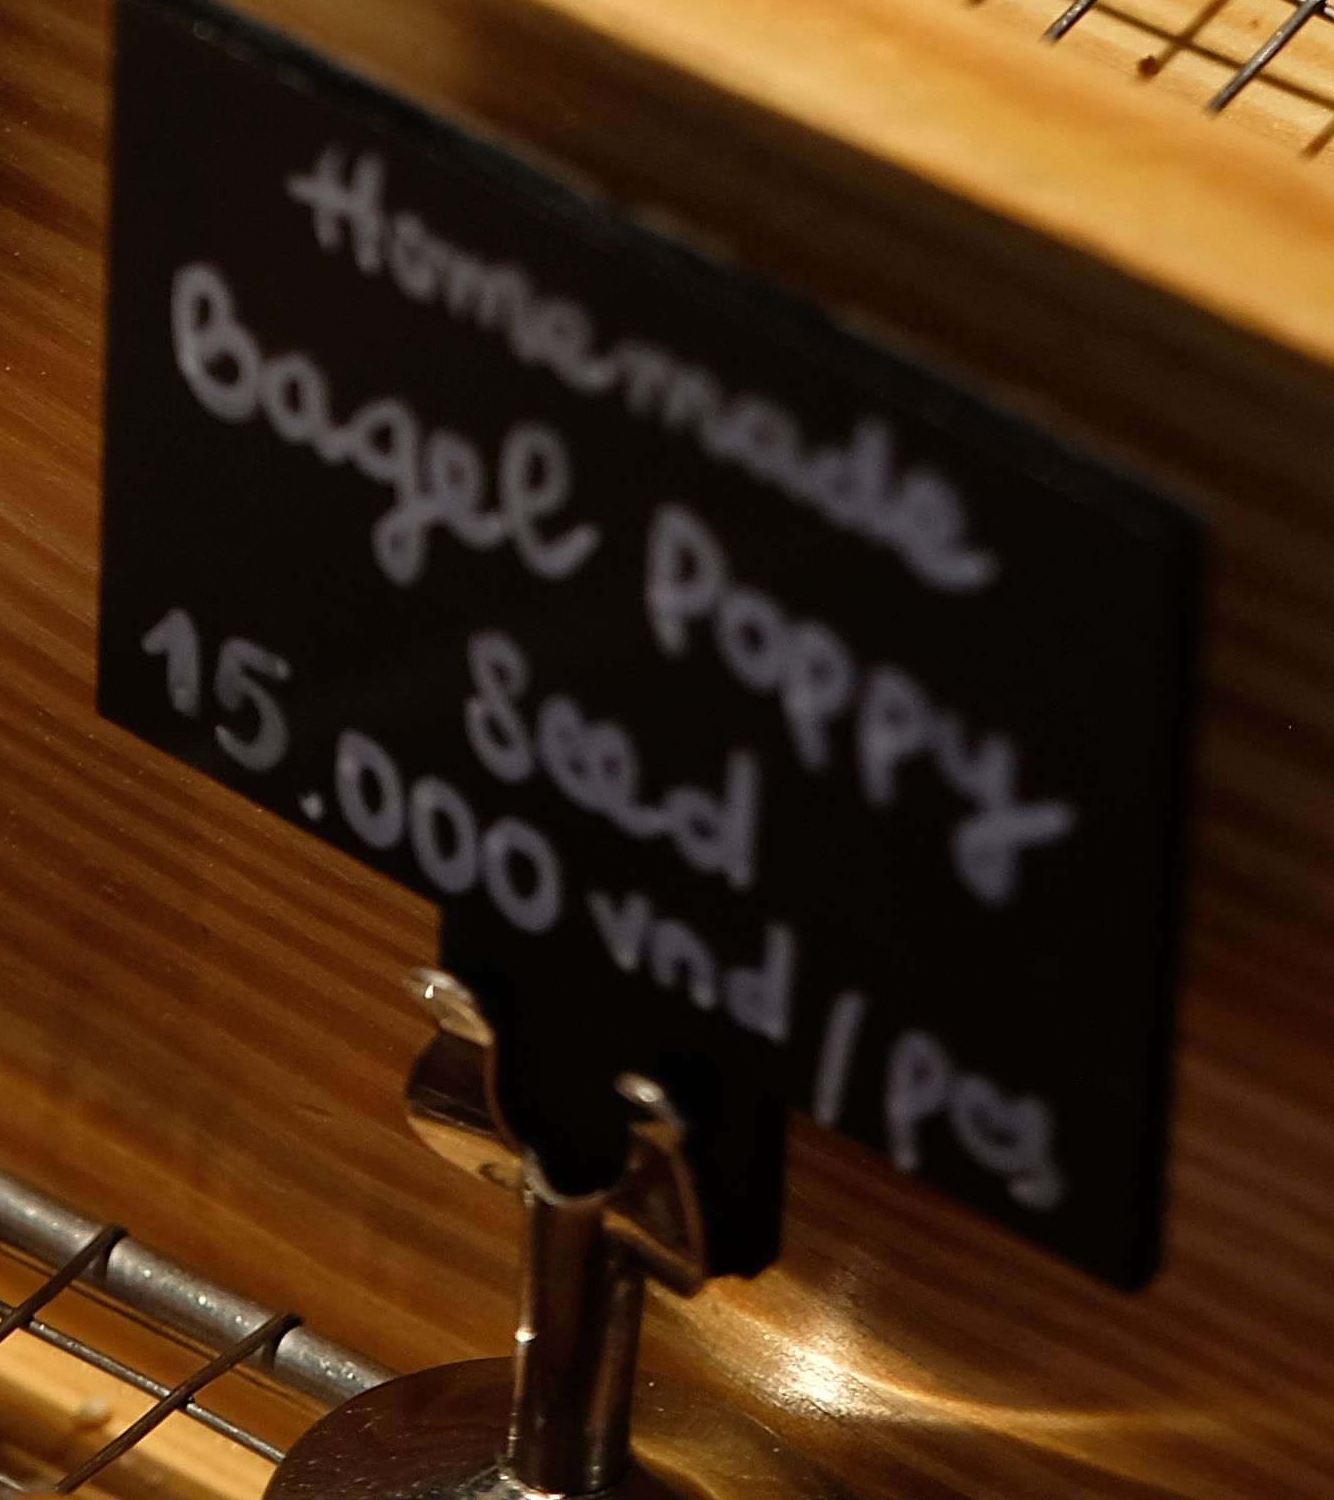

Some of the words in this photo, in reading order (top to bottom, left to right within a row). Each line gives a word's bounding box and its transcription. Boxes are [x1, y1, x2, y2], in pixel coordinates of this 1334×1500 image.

[171, 262, 596, 586] Bagel
[286, 140, 998, 592] Homemade
[141, 607, 562, 933] 15.000
[469, 631, 758, 889] Seed
